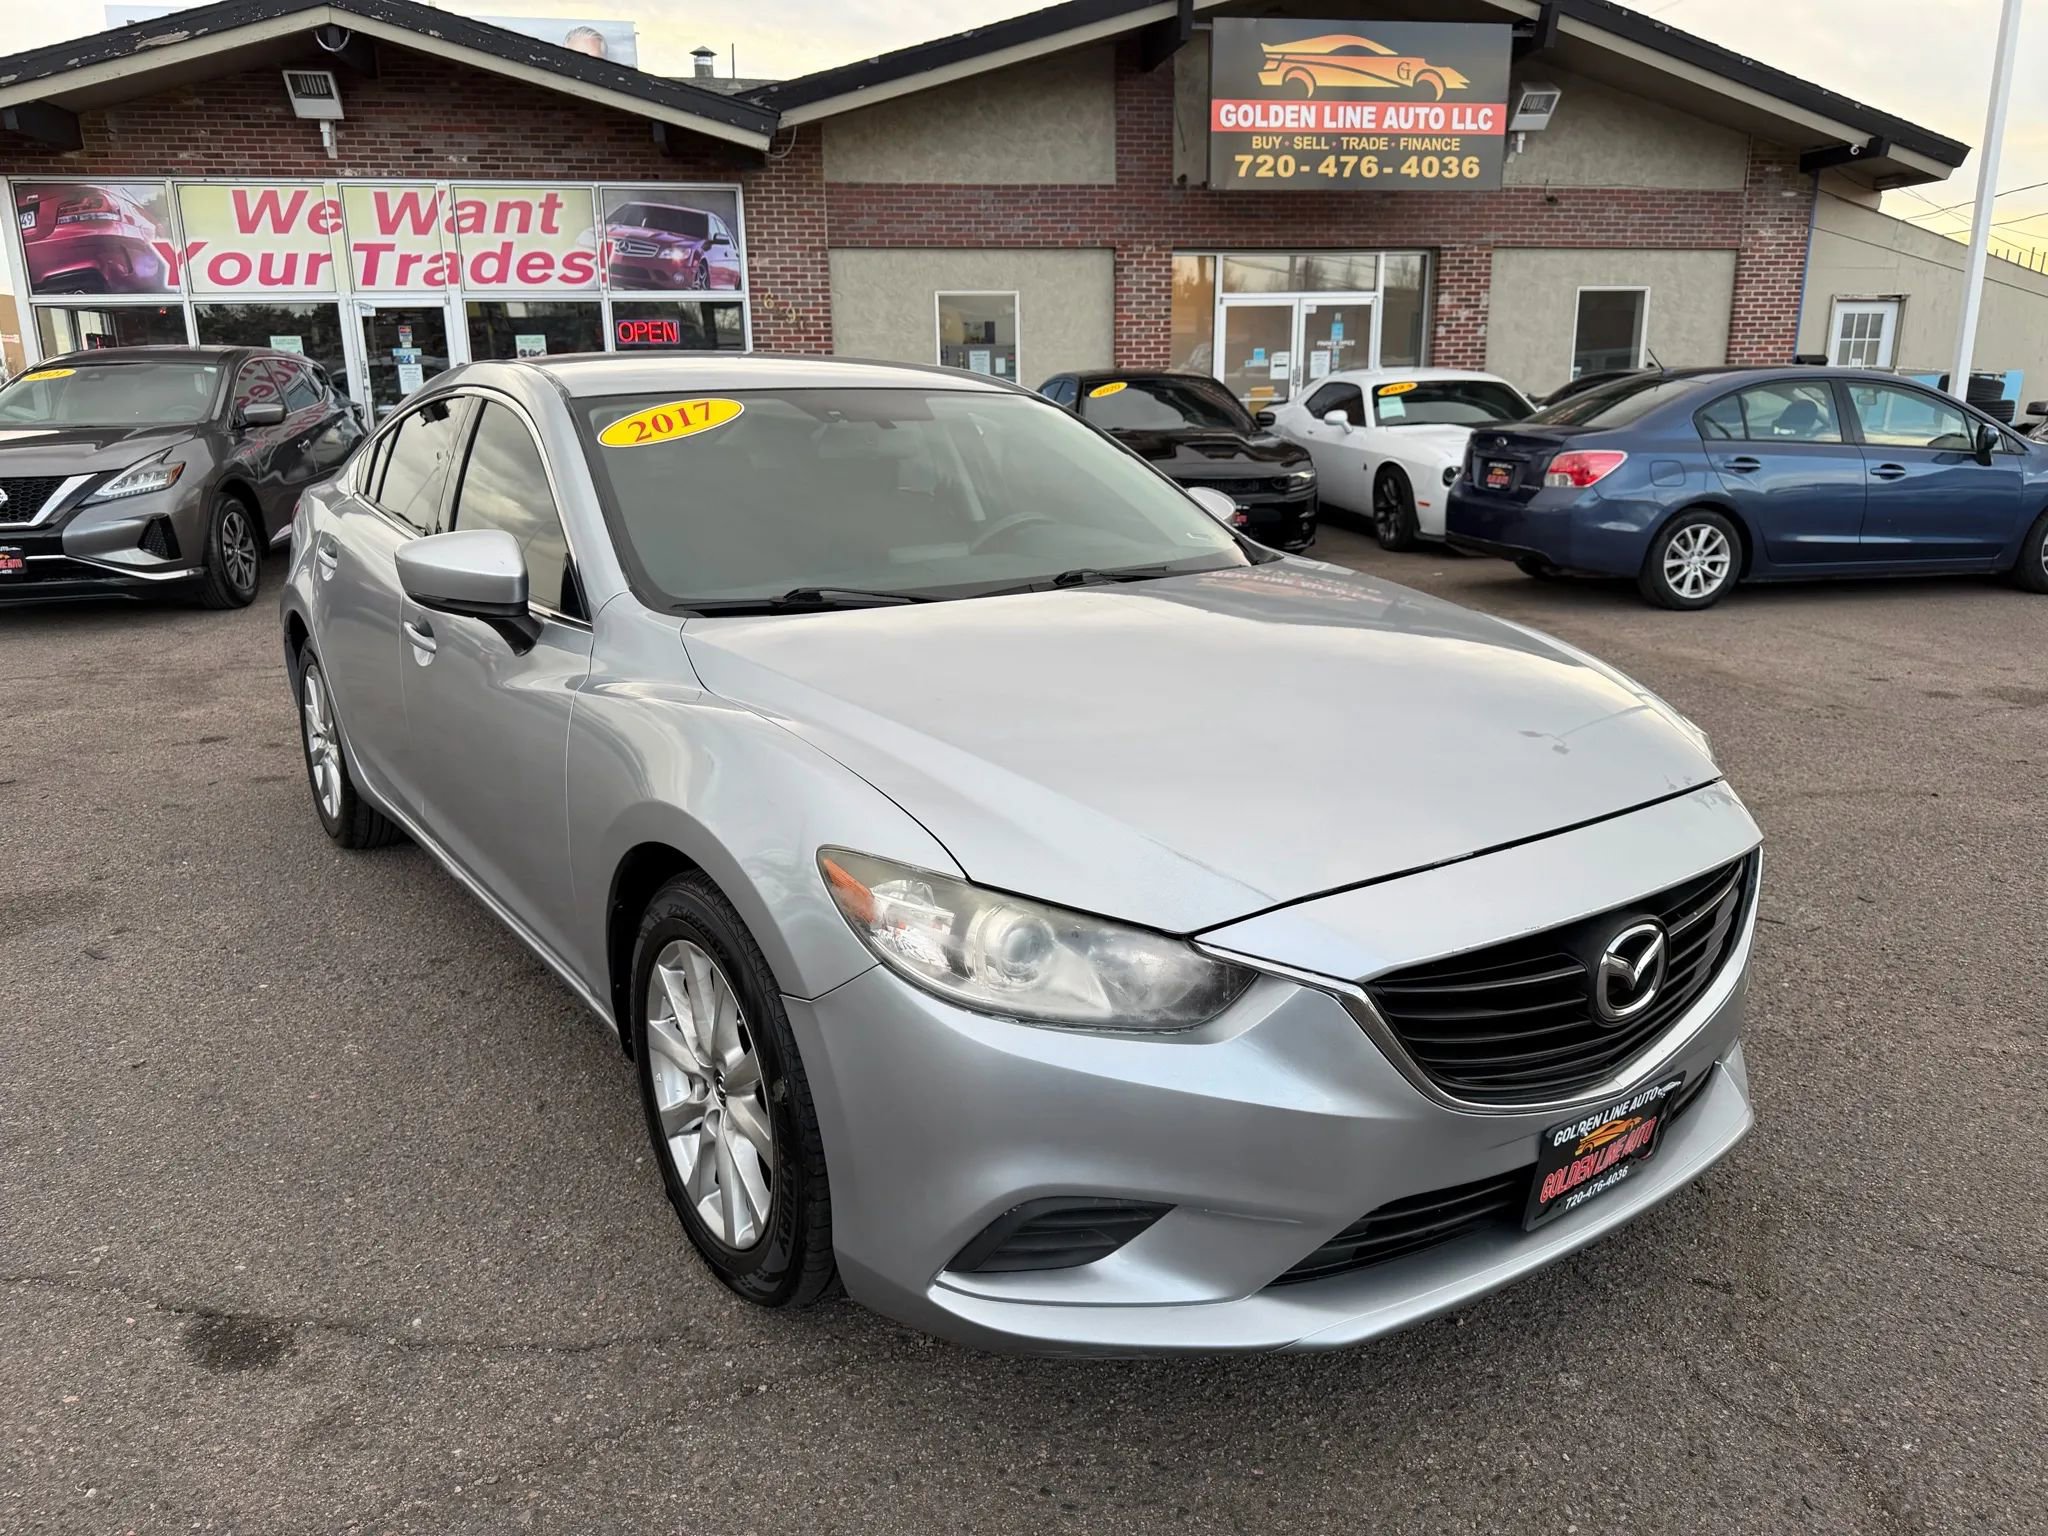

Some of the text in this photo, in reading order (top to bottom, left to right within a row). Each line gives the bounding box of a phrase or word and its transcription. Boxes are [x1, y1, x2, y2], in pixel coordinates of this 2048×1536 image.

[1219, 103, 1493, 131] GOLDEN LINE AUTO LLC
[1251, 135, 1461, 152] BUY SELL TRADE FINANCE
[1234, 154, 1480, 179] 720-476-4036
[231, 189, 563, 236] We Want
[152, 240, 614, 287] Your Trades!
[618, 320, 677, 344] OPEN
[627, 401, 710, 443] 2017
[1553, 1086, 1658, 1147] GOLDEN LINE AUTO
[1539, 1117, 1657, 1204] GOLDEN LINE AUTO
[1565, 1165, 1629, 1210] 720-476-4036
